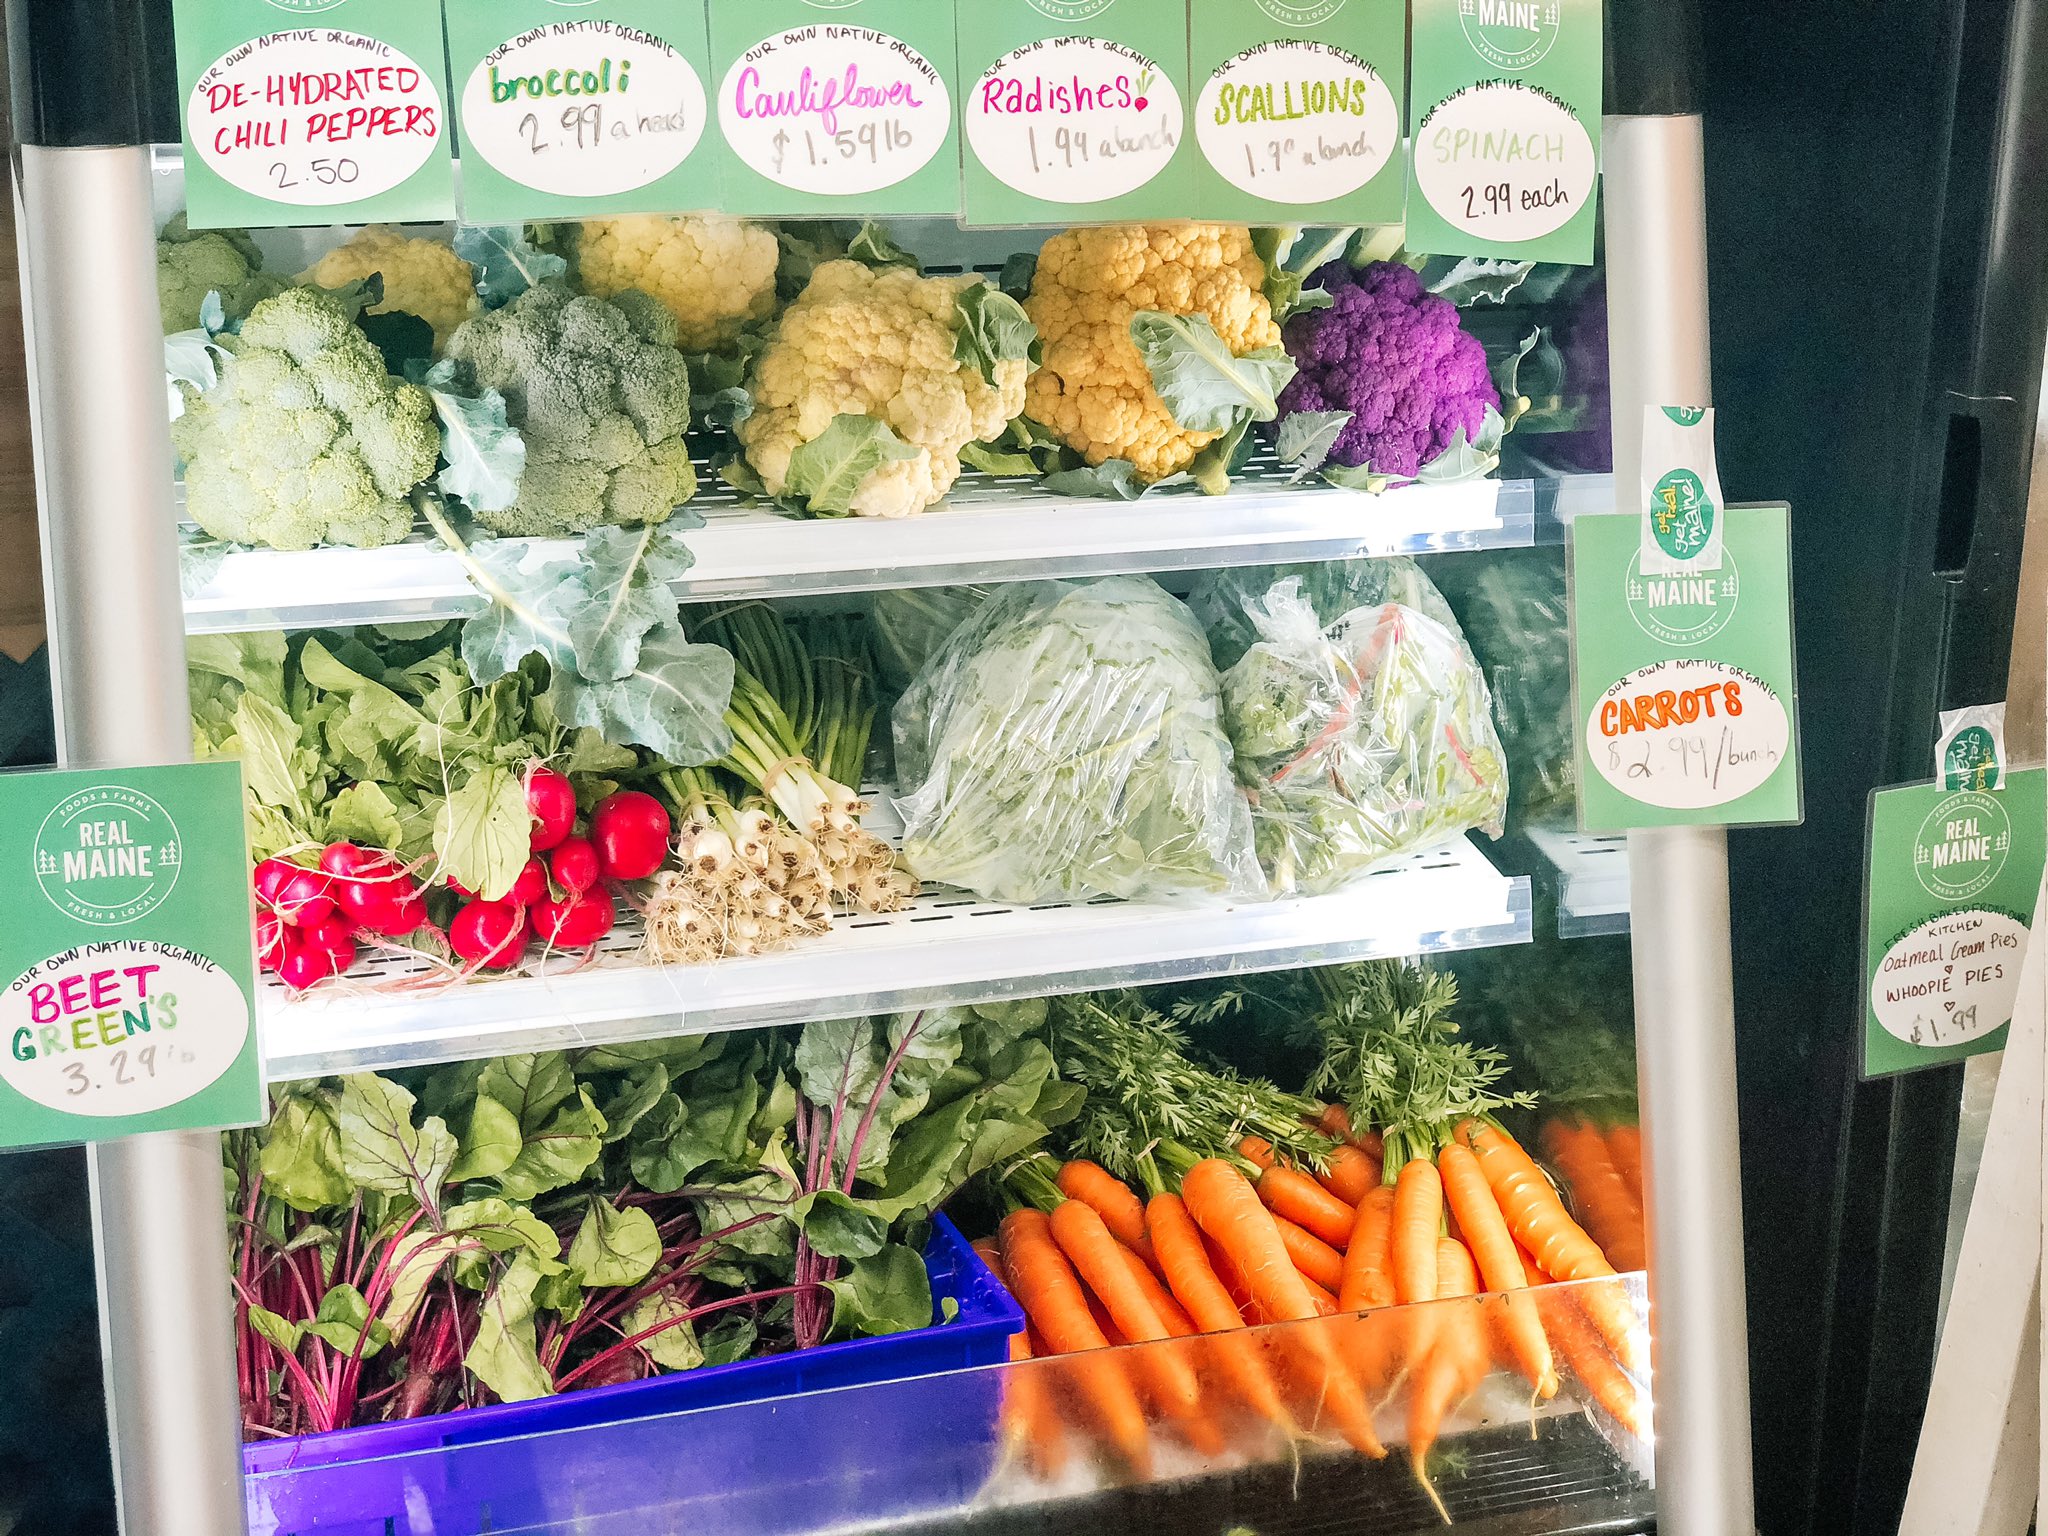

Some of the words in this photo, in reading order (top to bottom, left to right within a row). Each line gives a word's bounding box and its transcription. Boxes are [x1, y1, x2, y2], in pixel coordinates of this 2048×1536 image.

[1039, 0, 1064, 15] RESH
[1080, 0, 1104, 15] LOCA
[1265, 1, 1292, 20] FRESH
[1306, 2, 1335, 21] LOCAL
[1478, 0, 1541, 33] MAINE
[198, 67, 223, 93] OUR
[225, 43, 253, 67] OWN
[259, 30, 319, 49] NATIVE
[327, 31, 391, 57] ORGANIC
[485, 43, 515, 66] OUR
[516, 24, 547, 48] OWN
[552, 19, 613, 36] NATIVE
[615, 24, 674, 58] ORGANIC
[746, 42, 777, 62] OUR
[784, 26, 817, 45] OWN
[826, 27, 888, 45] NATIVE
[890, 41, 938, 85] ORGANIC
[984, 59, 1007, 78] OUR
[1013, 40, 1043, 60] OWN
[1054, 35, 1095, 49] NATIVE
[1103, 42, 1157, 72] ORGANIC
[1211, 60, 1236, 79] OUR
[1238, 41, 1268, 61] OWN
[1274, 38, 1322, 54] NATIVE
[1327, 44, 1377, 82] ORGANIC
[1478, 42, 1503, 64] FRESH
[1516, 49, 1541, 65] LOCAL
[206, 66, 419, 113] DE-HYDRATED
[488, 57, 631, 103] broccoli
[735, 62, 923, 135] Cauliflower
[982, 75, 1131, 114] Radishes
[1214, 77, 1367, 126] SCALLIONS
[1420, 105, 1439, 128] OUR
[1440, 86, 1466, 107] OWN
[1475, 77, 1524, 93] NATIVE
[1529, 84, 1578, 122] ORGANIC
[214, 118, 287, 154] CHILI
[306, 105, 437, 143] PEPPERS
[518, 104, 602, 154] 2.99
[1432, 126, 1564, 164] SPINACH
[269, 158, 359, 188] 2.50
[1461, 183, 1511, 219] 2.99
[1520, 178, 1569, 211] each
[1655, 510, 1671, 535] get
[1672, 520, 1689, 553] get
[1648, 579, 1718, 609] MAINE
[1649, 623, 1678, 642] FRESH
[1691, 622, 1719, 641] LOCAL
[1607, 677, 1632, 697] OUR
[1638, 660, 1666, 678] OWN
[1676, 659, 1725, 672] NATIVE
[1729, 666, 1777, 701] ORGANIC
[1600, 680, 1743, 737] CARROTS
[59, 793, 97, 817] FOODS
[114, 791, 152, 812] FARMS
[79, 819, 134, 847] REAL
[1945, 817, 1981, 841] REAL
[63, 845, 154, 883] MAINE
[1932, 836, 1992, 869] MAINE
[67, 901, 102, 919] FRESH
[121, 895, 157, 917] LOCAL
[1883, 918, 1927, 950] FRESH
[1928, 918, 1983, 938] KITCHEN
[12, 967, 41, 992] OUR
[45, 947, 80, 970] OWN
[87, 939, 147, 957] NATIVE
[152, 942, 217, 973] ORGANIC
[1883, 943, 1944, 973] Oatmeal
[1950, 940, 1985, 961] Cream
[1990, 932, 2018, 949] Pies
[27, 964, 160, 1024] BEET
[1886, 976, 1952, 1002] WHOOPIE
[1965, 964, 2003, 985] PIES
[12, 992, 178, 1061] GREEN'S
[62, 1045, 157, 1095] 3.29
